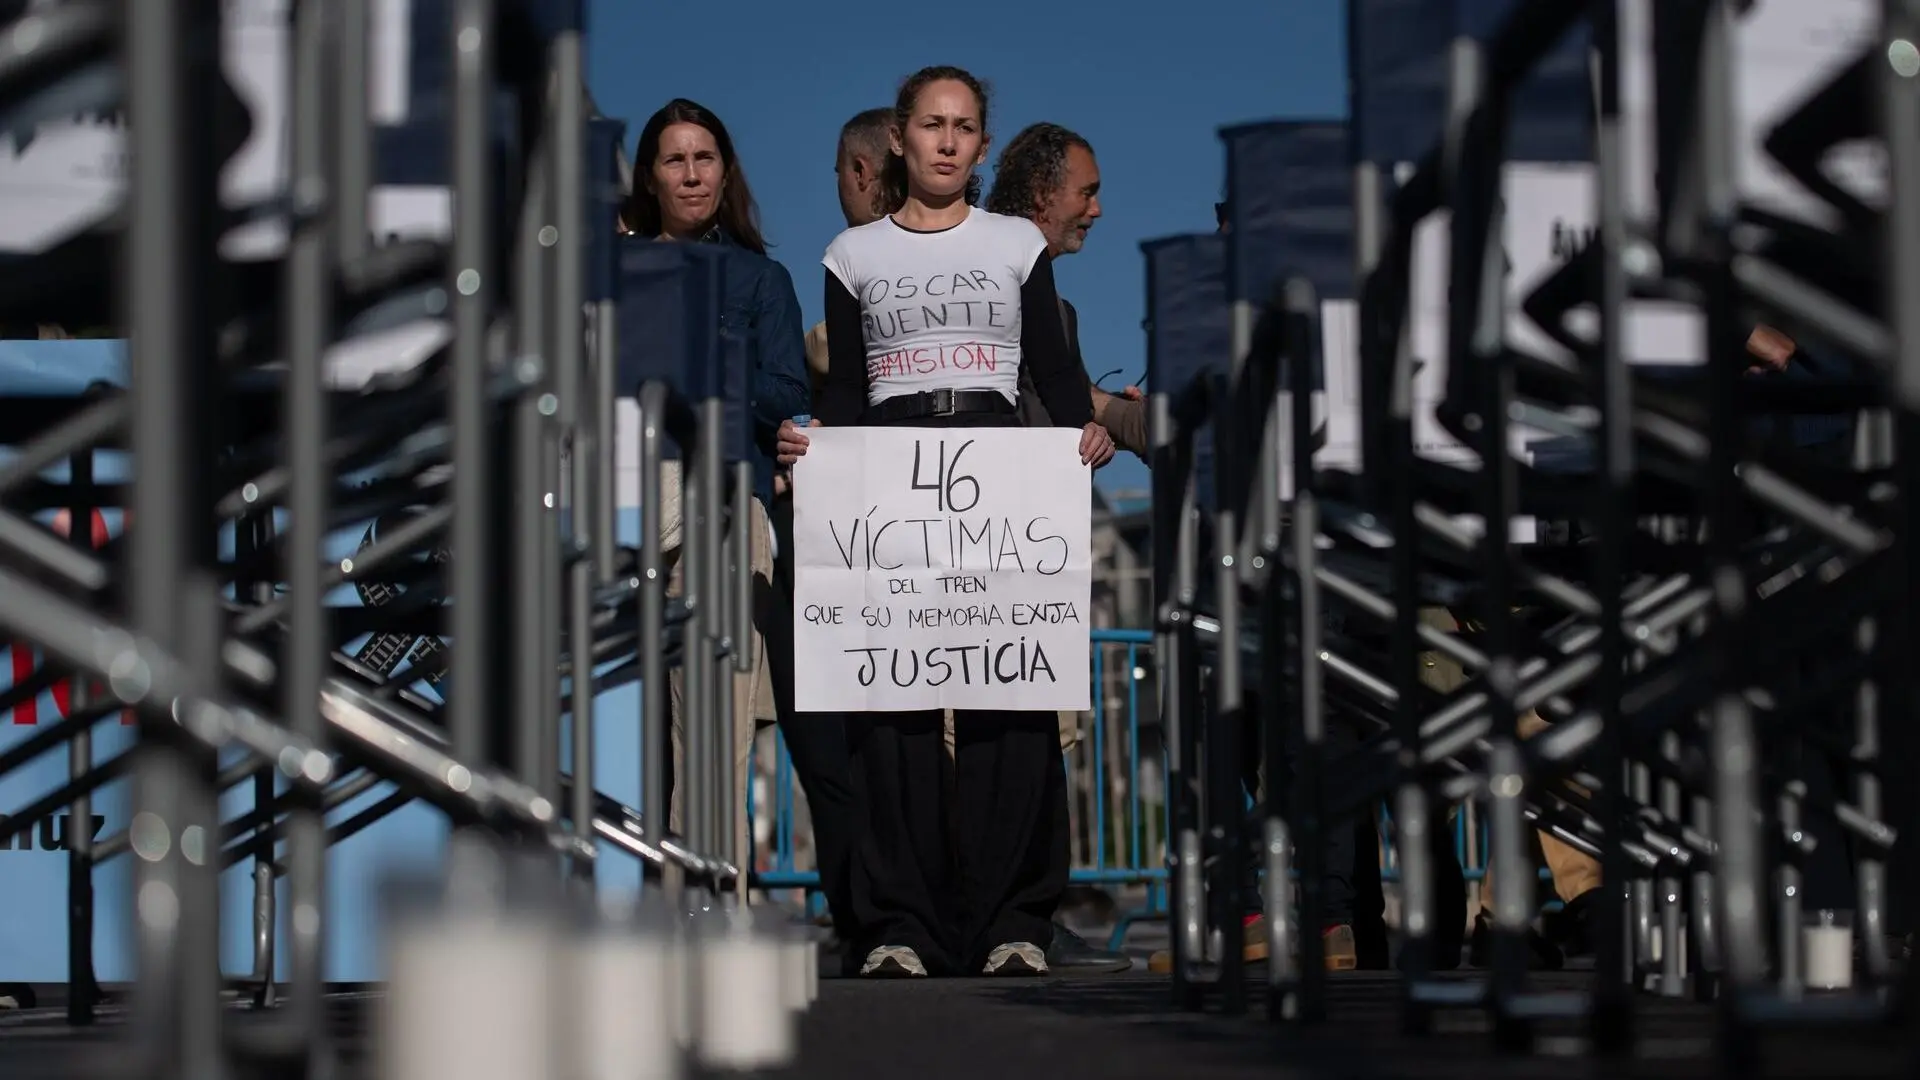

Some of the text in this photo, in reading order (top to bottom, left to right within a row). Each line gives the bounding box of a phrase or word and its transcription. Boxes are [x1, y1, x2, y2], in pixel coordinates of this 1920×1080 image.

[868, 269, 1000, 305] OSCAR
[863, 301, 1006, 341] PUENTE
[911, 440, 980, 512] 46
[829, 505, 1068, 576] VÍCTIMAS
[888, 576, 987, 595] DEL TREN
[804, 601, 1080, 629] QUE SU MEMORIA EXIJA
[844, 636, 1057, 687] JUSTICIA
